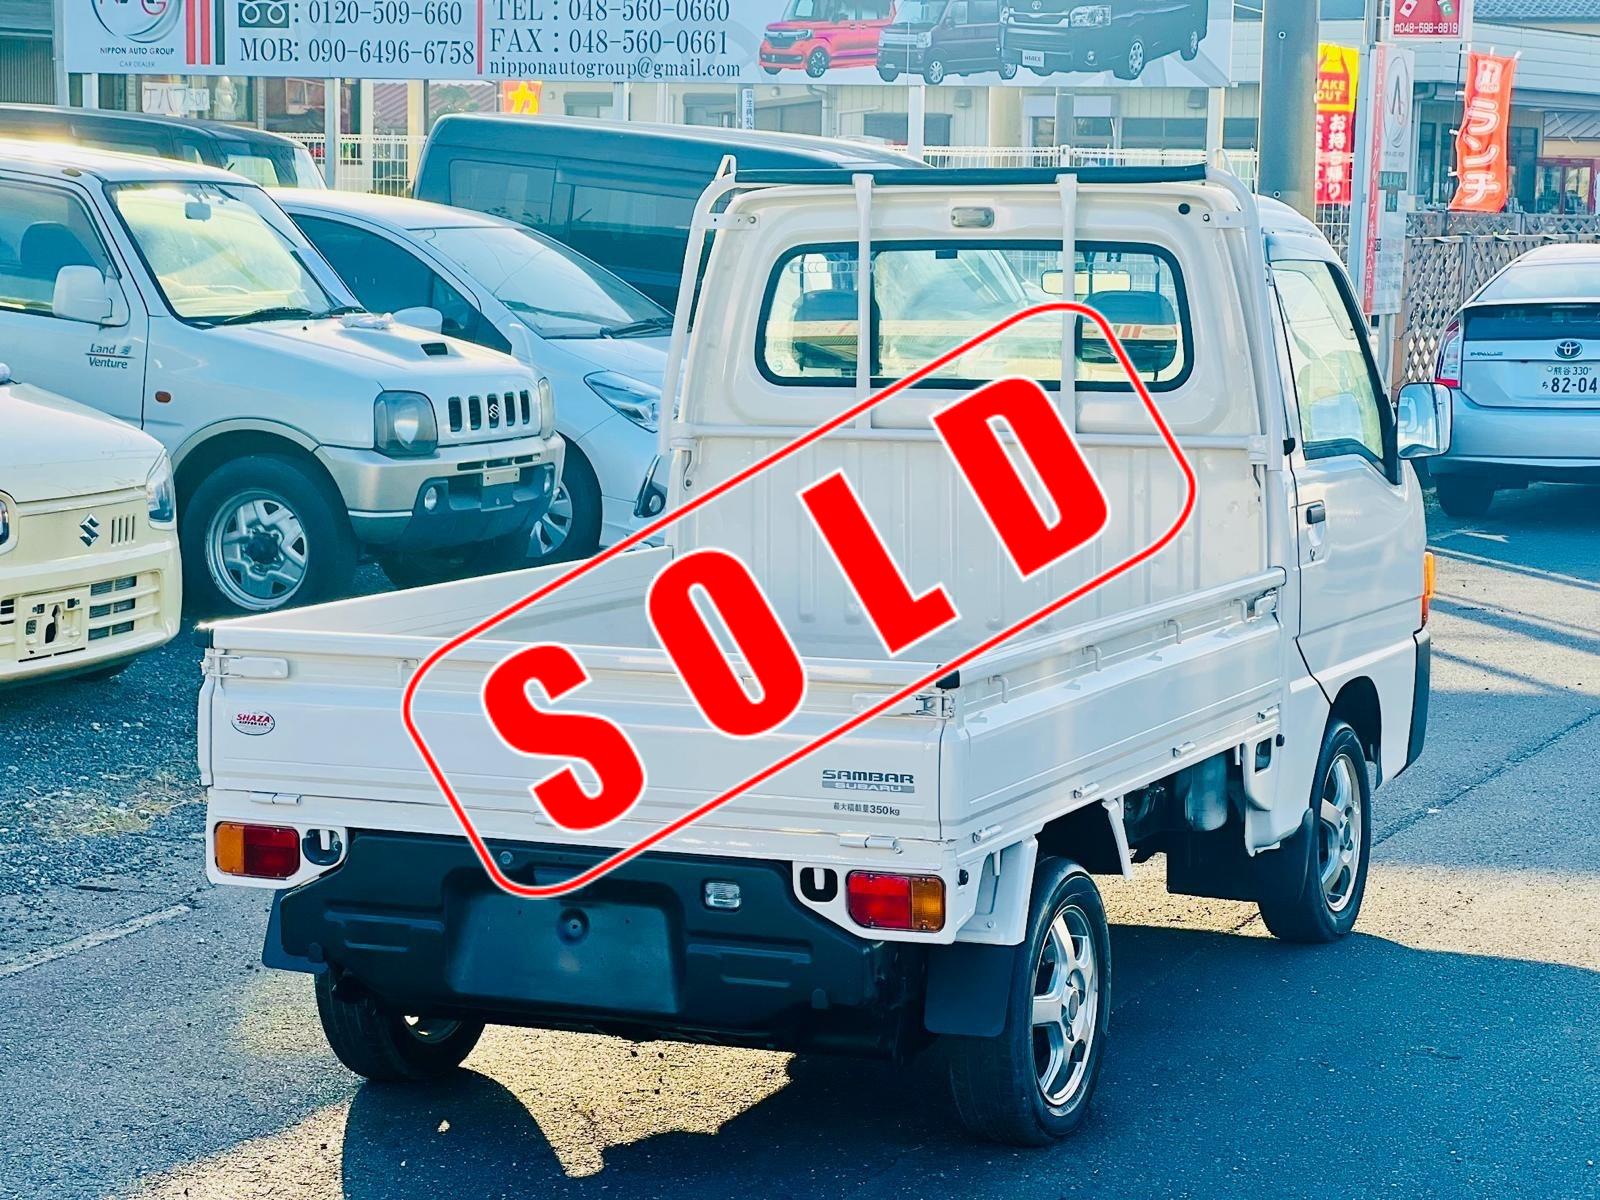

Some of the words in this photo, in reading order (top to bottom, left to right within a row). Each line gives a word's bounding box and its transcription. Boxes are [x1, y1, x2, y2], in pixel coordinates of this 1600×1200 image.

[308, 1, 462, 25] 0120-509-660
[568, 0, 730, 22] 048-560-0660
[569, 29, 728, 54] 048-560-0661
[100, 47, 127, 55] NIPPON
[129, 47, 148, 55] AUTO
[150, 48, 175, 56] GROUP
[308, 39, 475, 65] 090-6496-6758
[489, 57, 741, 79] nipponautogroup@gmail.com
[1316, 91, 1343, 102] OUT
[1463, 97, 1502, 206] ランチ
[90, 343, 116, 354] Land
[89, 356, 128, 369] Venture
[1572, 366, 1589, 376] 330
[1551, 377, 1598, 393] 82-04
[236, 713, 271, 724] SHAZA
[821, 769, 915, 784] SAMBAR
[834, 782, 902, 792] SUBARU
